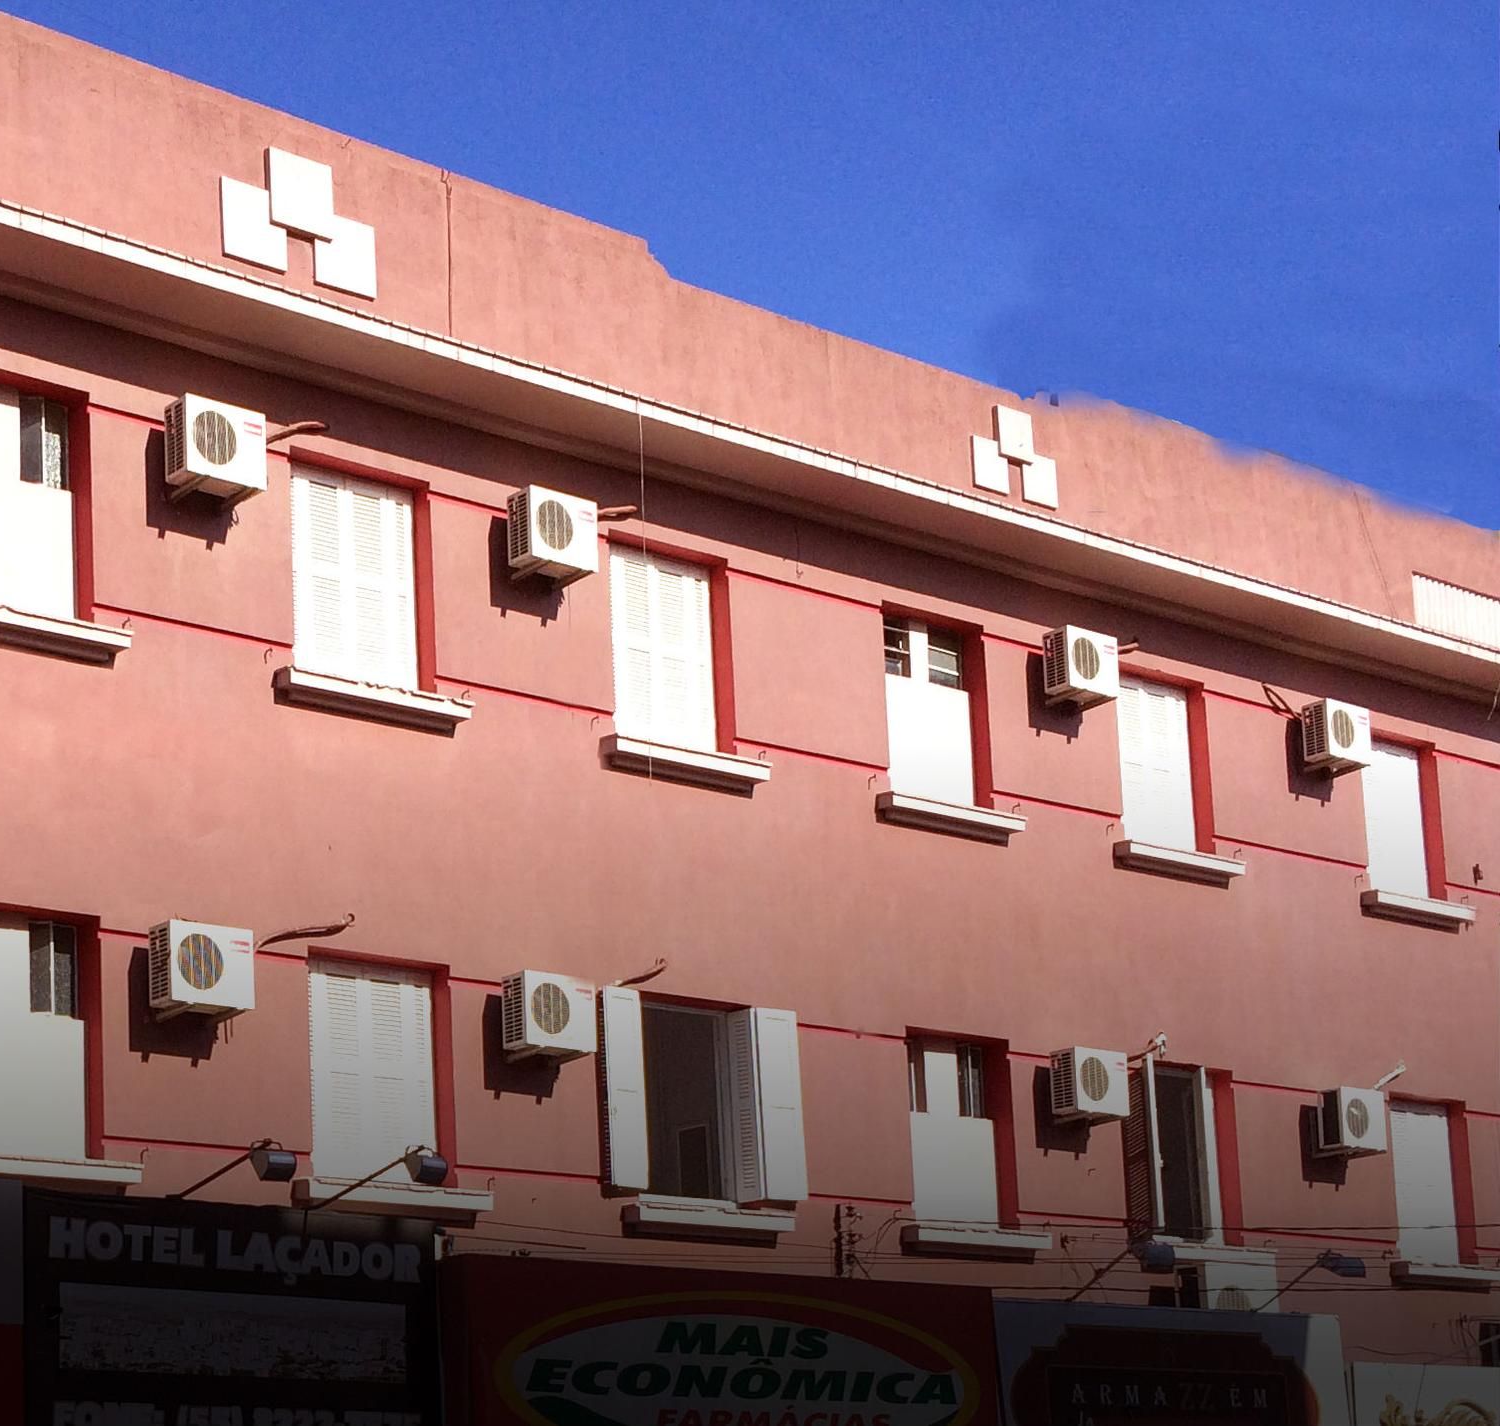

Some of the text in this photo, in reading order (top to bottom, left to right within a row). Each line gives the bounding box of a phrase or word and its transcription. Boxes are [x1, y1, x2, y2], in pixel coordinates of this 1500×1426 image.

[49, 1216, 420, 1285] HOTEL LAÇADOR
[654, 1321, 829, 1359] MAIS
[524, 1358, 958, 1405] ECONÔMICA
